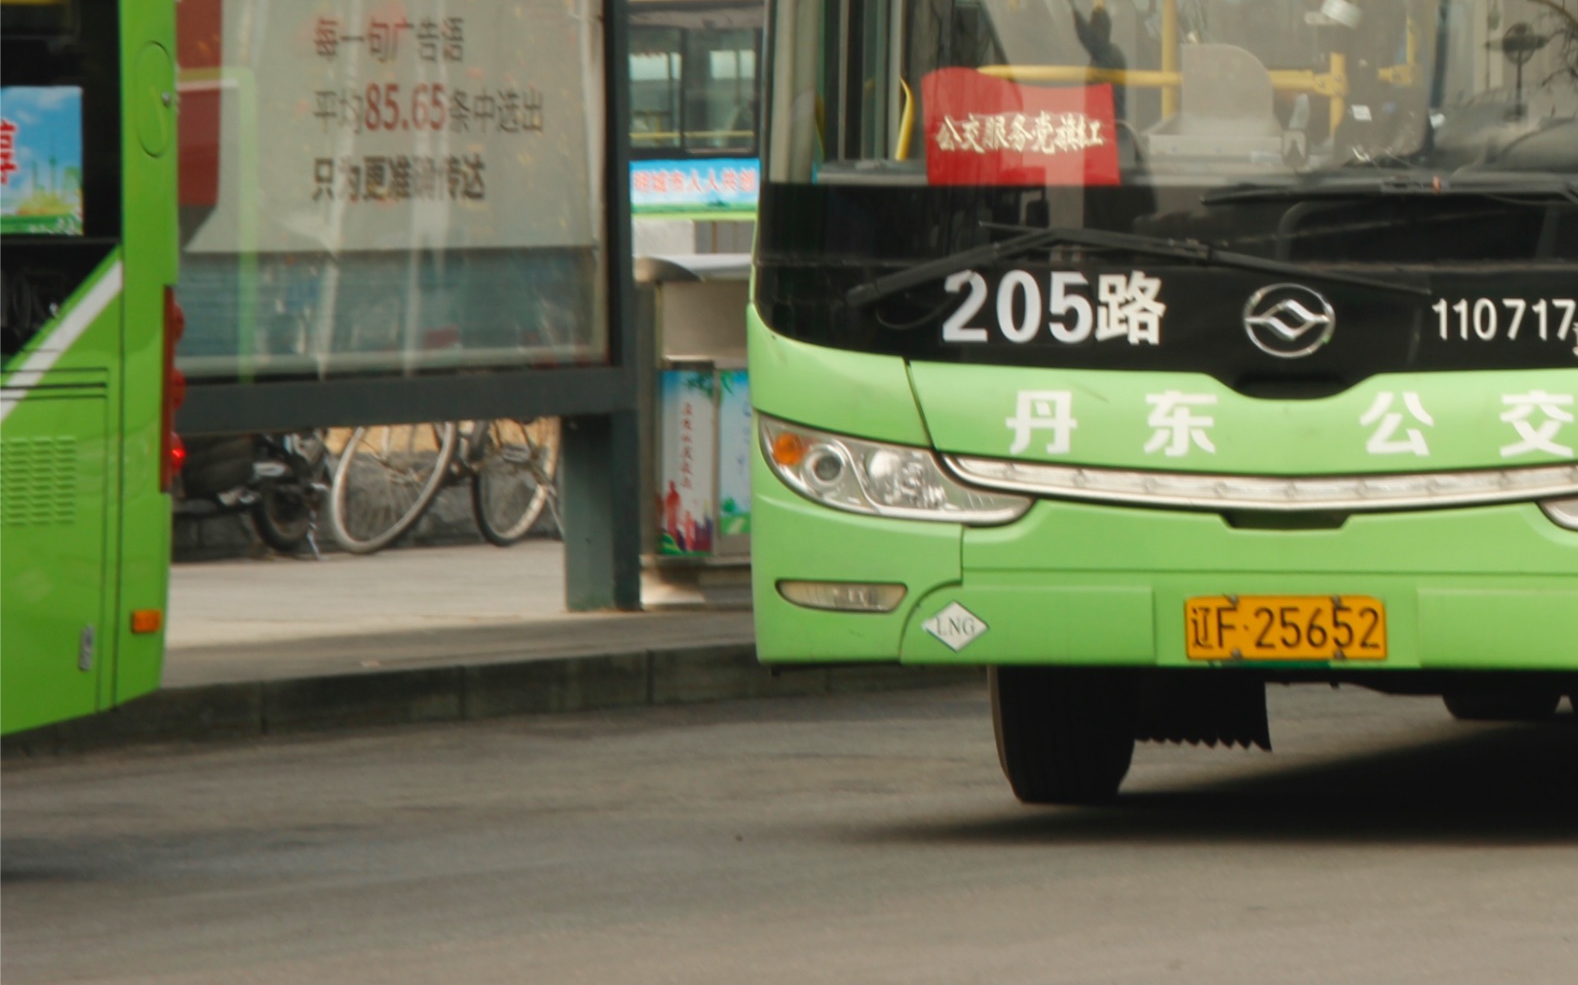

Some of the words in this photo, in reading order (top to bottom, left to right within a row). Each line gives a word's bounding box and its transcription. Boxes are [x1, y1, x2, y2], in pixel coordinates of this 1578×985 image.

[314, 17, 465, 62] 每一句广告语
[935, 111, 1104, 155] 公交服务党旗红
[942, 269, 1167, 345] 205路
[1432, 297, 1577, 341] 110717
[1005, 390, 1575, 458] 丹东公交
[936, 617, 976, 636] LNG
